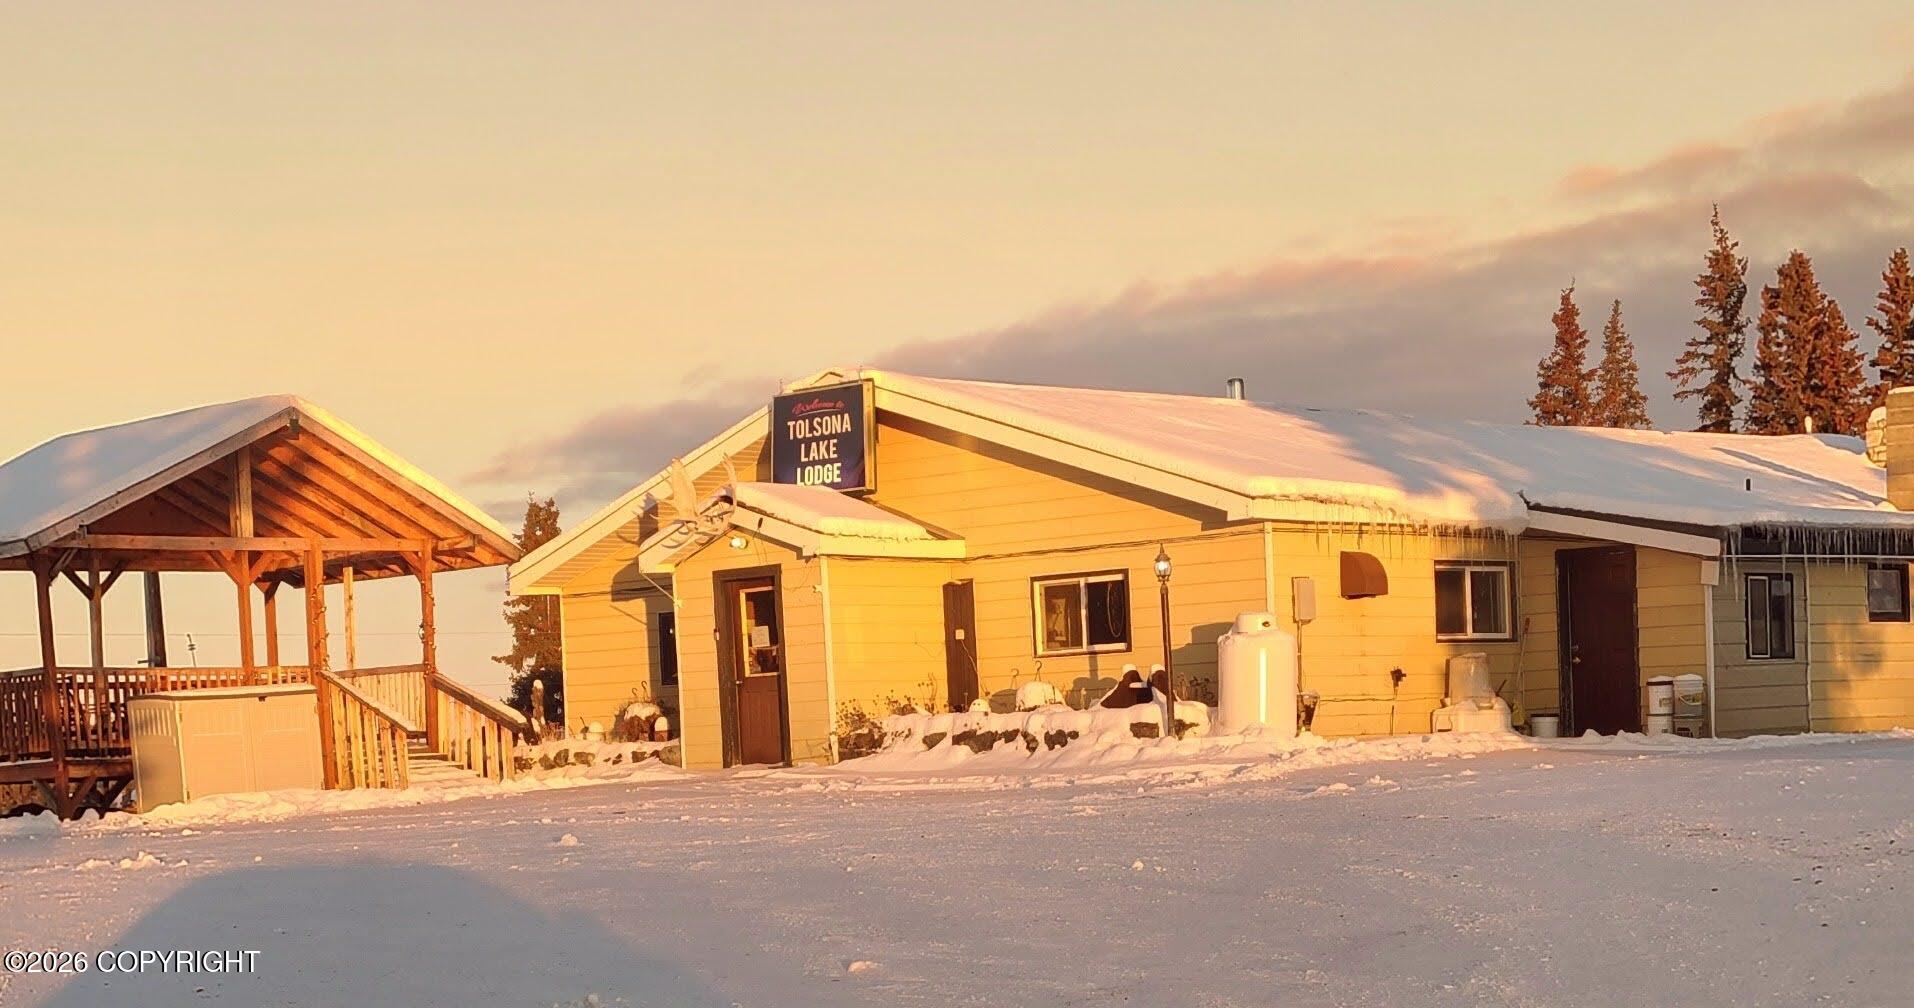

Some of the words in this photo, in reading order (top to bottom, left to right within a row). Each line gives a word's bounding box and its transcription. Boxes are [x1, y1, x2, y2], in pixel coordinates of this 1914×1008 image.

[787, 413, 852, 440] TOLSONA
[800, 439, 838, 462] LAKE
[796, 462, 842, 486] LODGE
